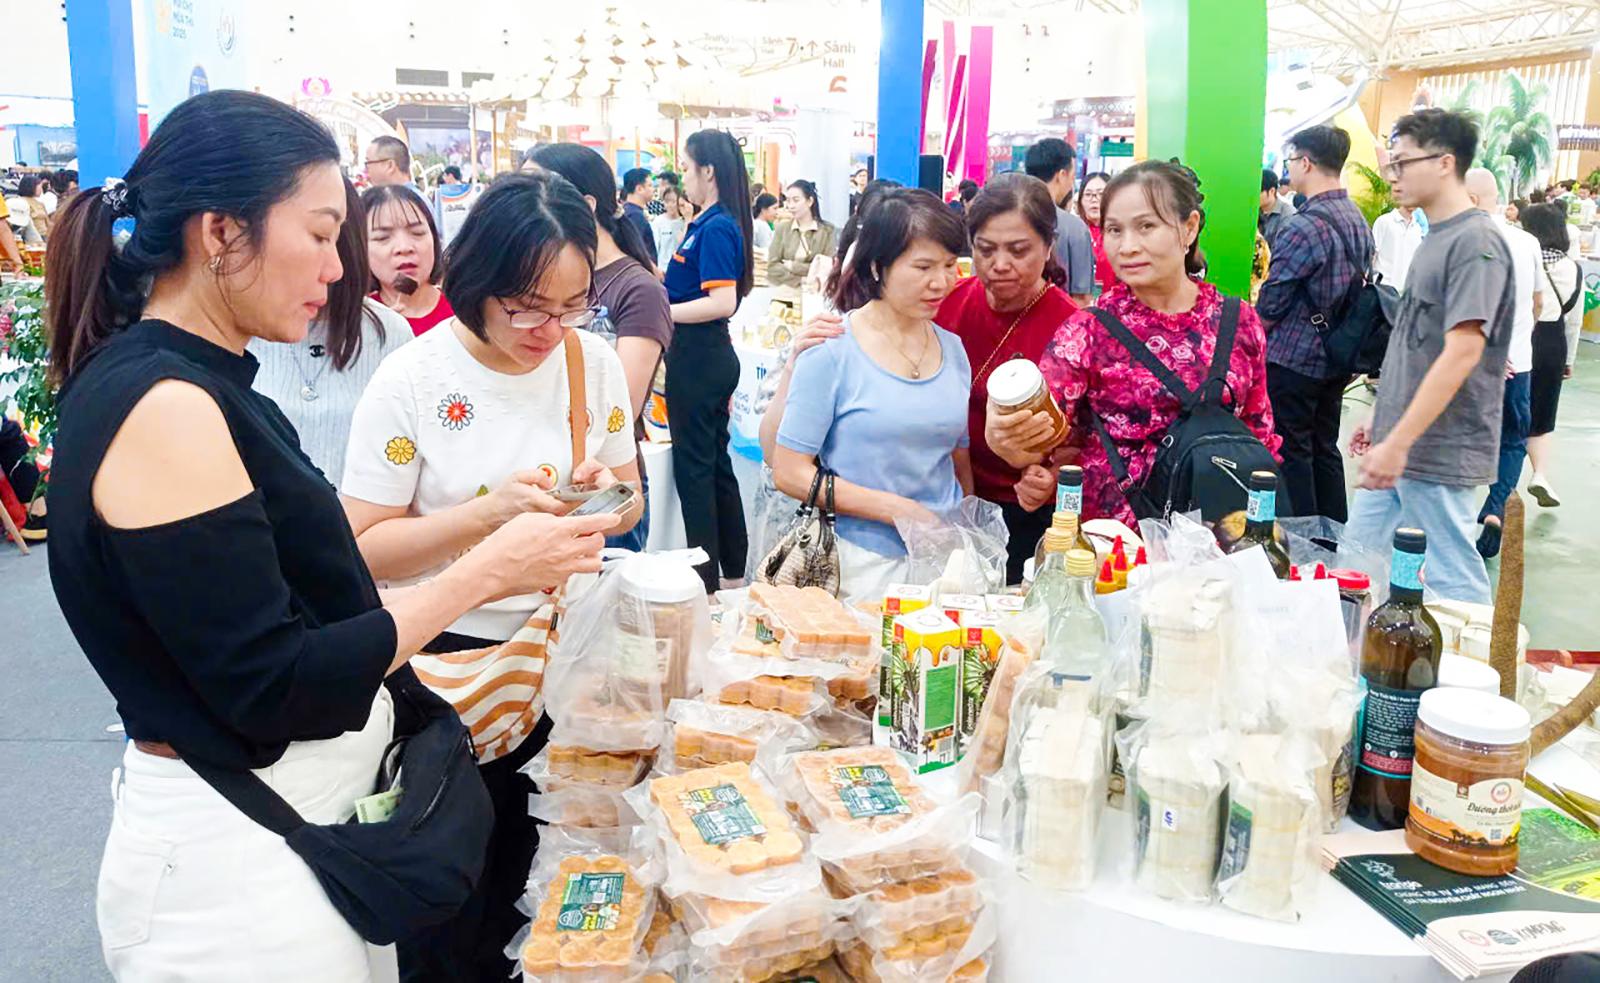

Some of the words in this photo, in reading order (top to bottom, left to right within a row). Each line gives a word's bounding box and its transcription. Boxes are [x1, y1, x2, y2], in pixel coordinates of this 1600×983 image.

[786, 37, 797, 55] 7
[823, 40, 856, 54] Sảnh
[823, 58, 845, 68] Hall
